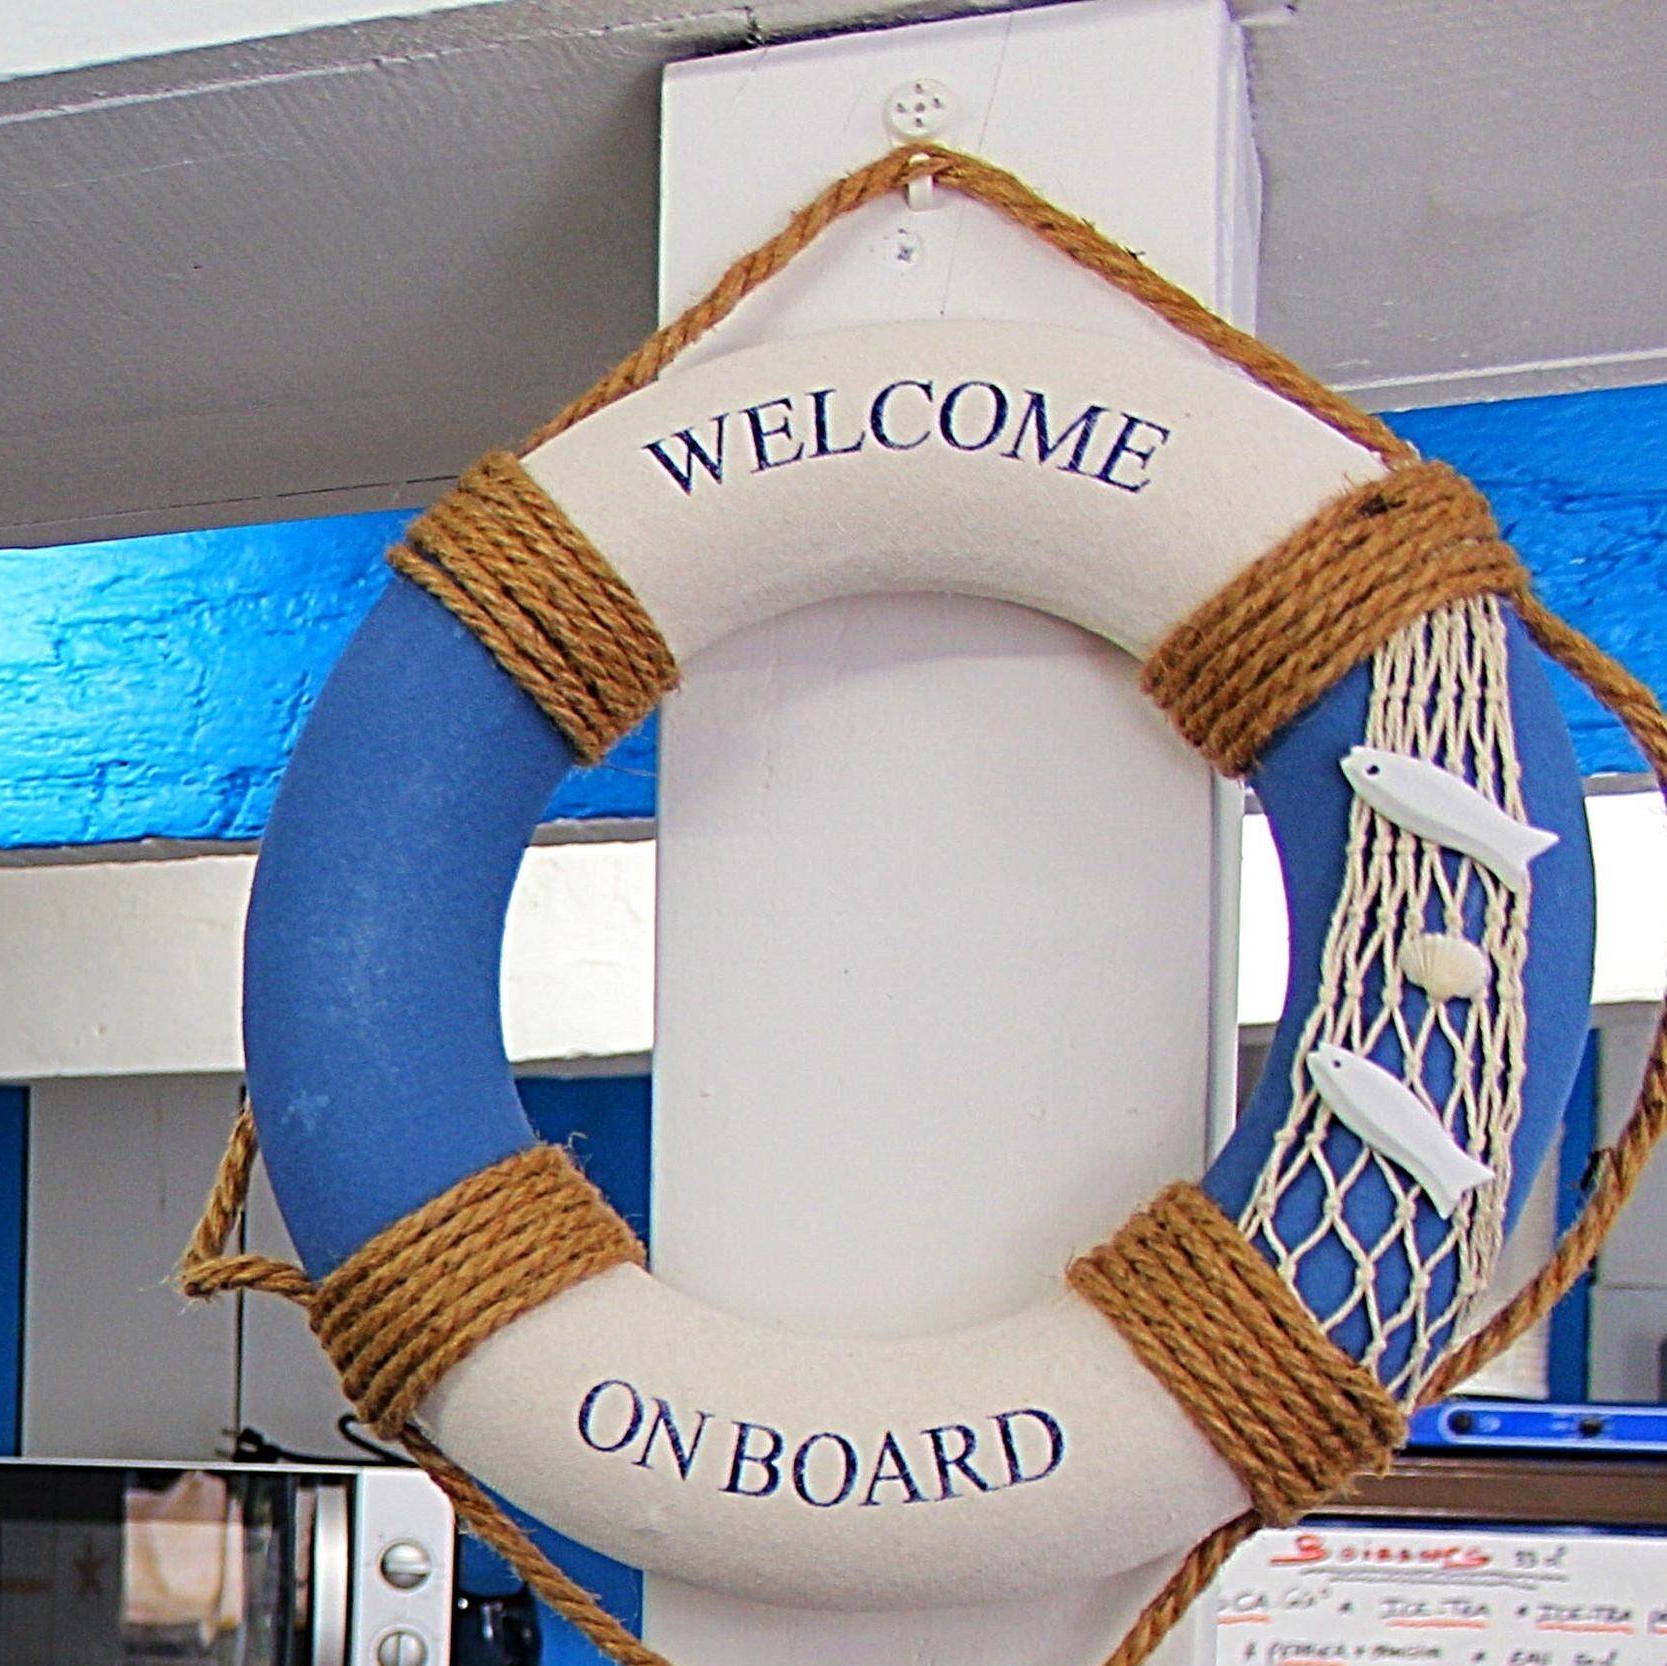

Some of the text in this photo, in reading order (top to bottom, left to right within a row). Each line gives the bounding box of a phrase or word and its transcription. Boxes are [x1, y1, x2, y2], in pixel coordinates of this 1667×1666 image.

[643, 379, 1171, 496] WELCOME
[577, 1378, 1065, 1509] ON BOARD
